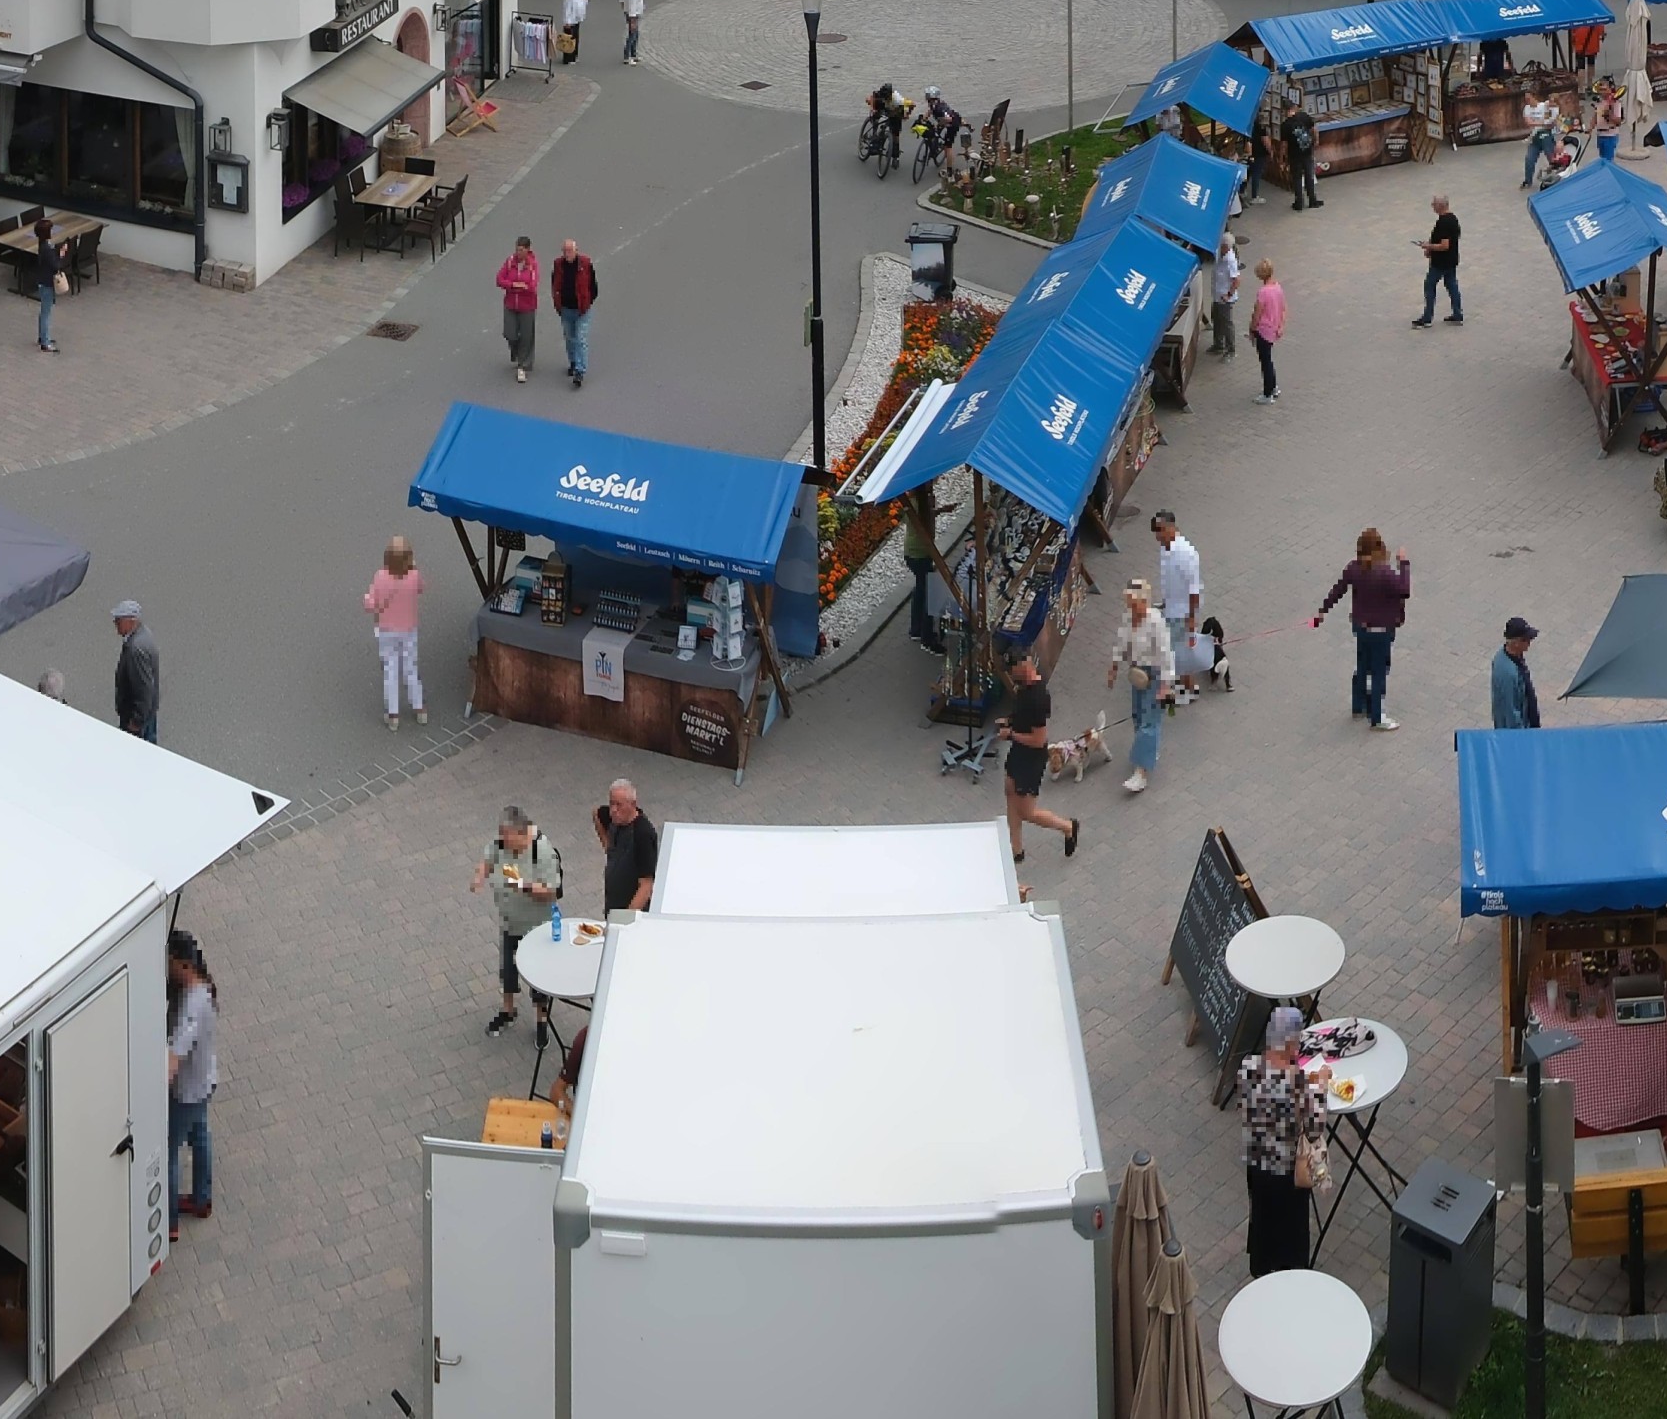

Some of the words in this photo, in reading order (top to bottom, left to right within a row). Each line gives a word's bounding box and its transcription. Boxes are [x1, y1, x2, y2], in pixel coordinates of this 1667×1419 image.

[1499, 4, 1541, 18] Seefeld
[1331, 24, 1374, 41] Seefeld
[1116, 268, 1147, 305] Seefeld
[1041, 393, 1078, 440] Seefeld
[555, 489, 582, 504] TIROLS
[584, 496, 640, 515] HOCHPLATEAU
[559, 464, 651, 503] Seefeld
[616, 540, 637, 552] Seefeld
[644, 546, 671, 559] Leutasch
[678, 553, 701, 565] Mösern
[708, 558, 725, 570] Reith
[731, 564, 761, 577] Scharnitz
